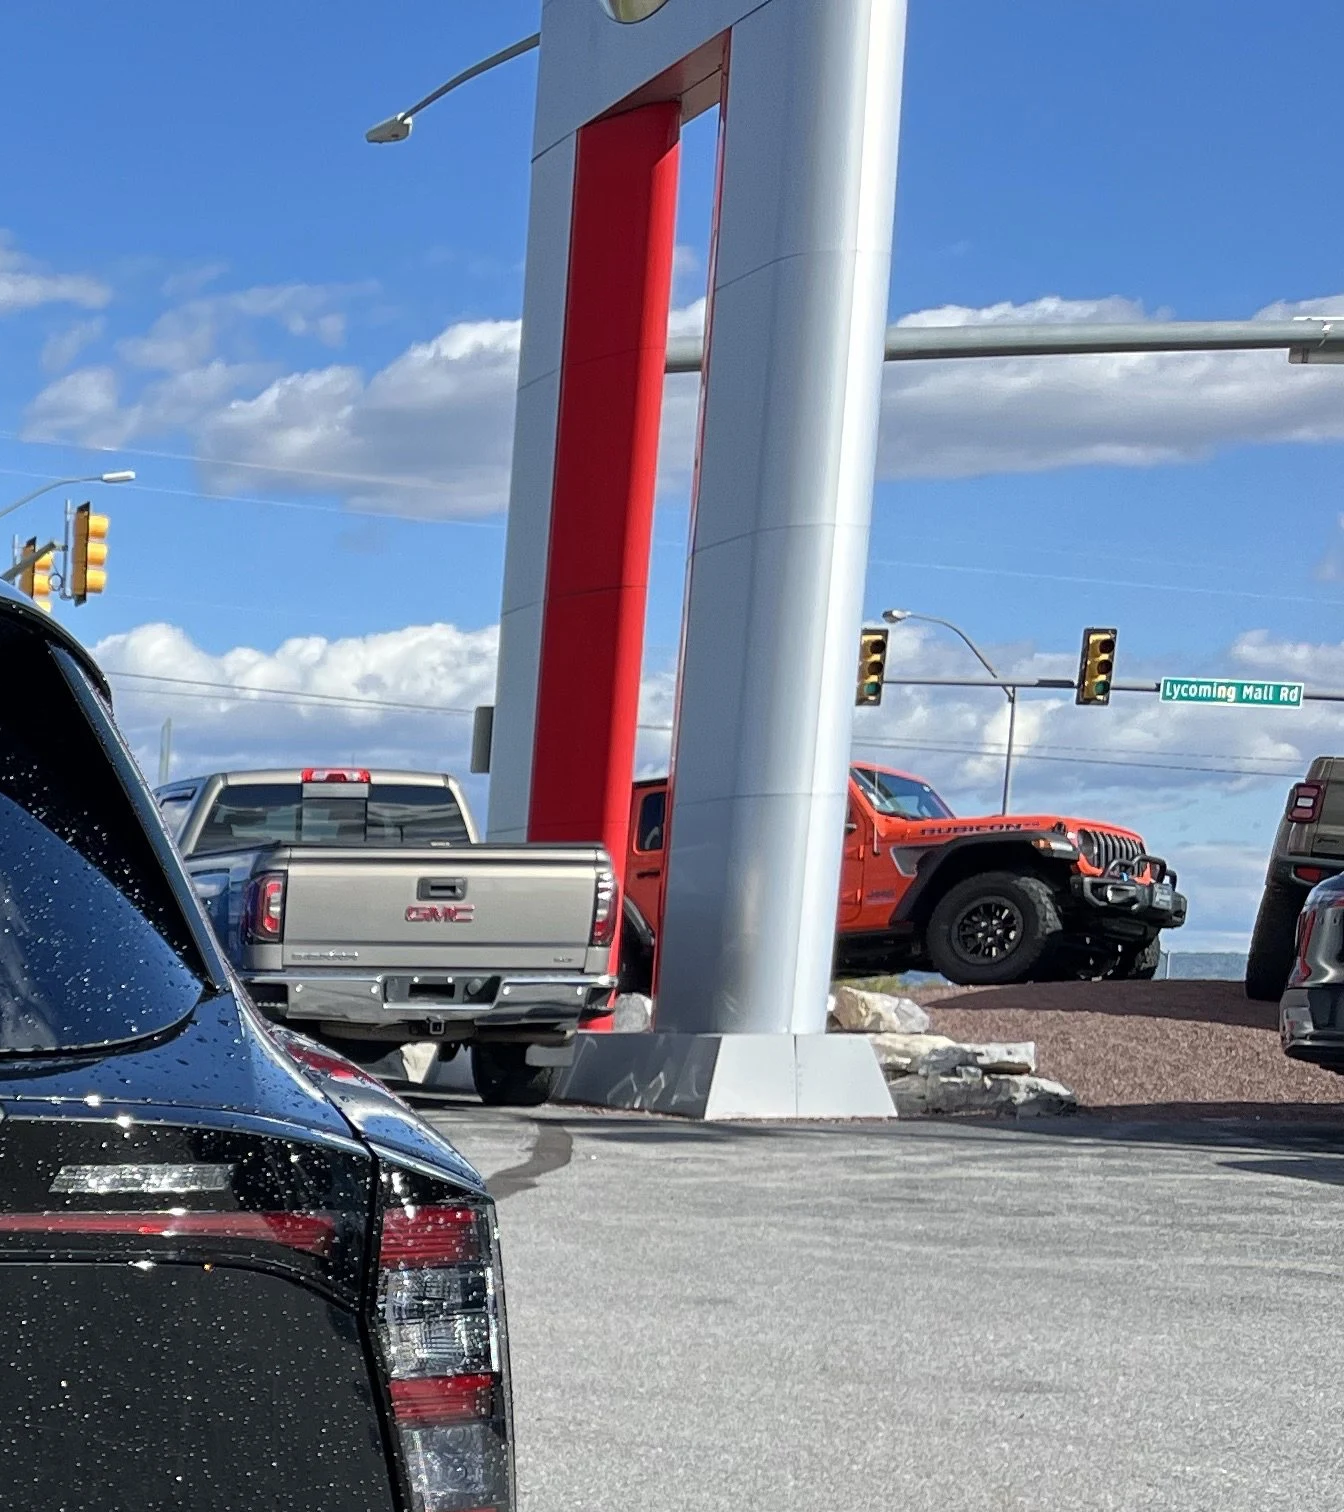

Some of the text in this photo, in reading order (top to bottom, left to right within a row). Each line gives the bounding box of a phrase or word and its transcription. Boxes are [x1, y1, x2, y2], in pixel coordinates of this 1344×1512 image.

[1165, 681, 1300, 702] Lycoming Mall Rd
[405, 905, 475, 922] GMC
